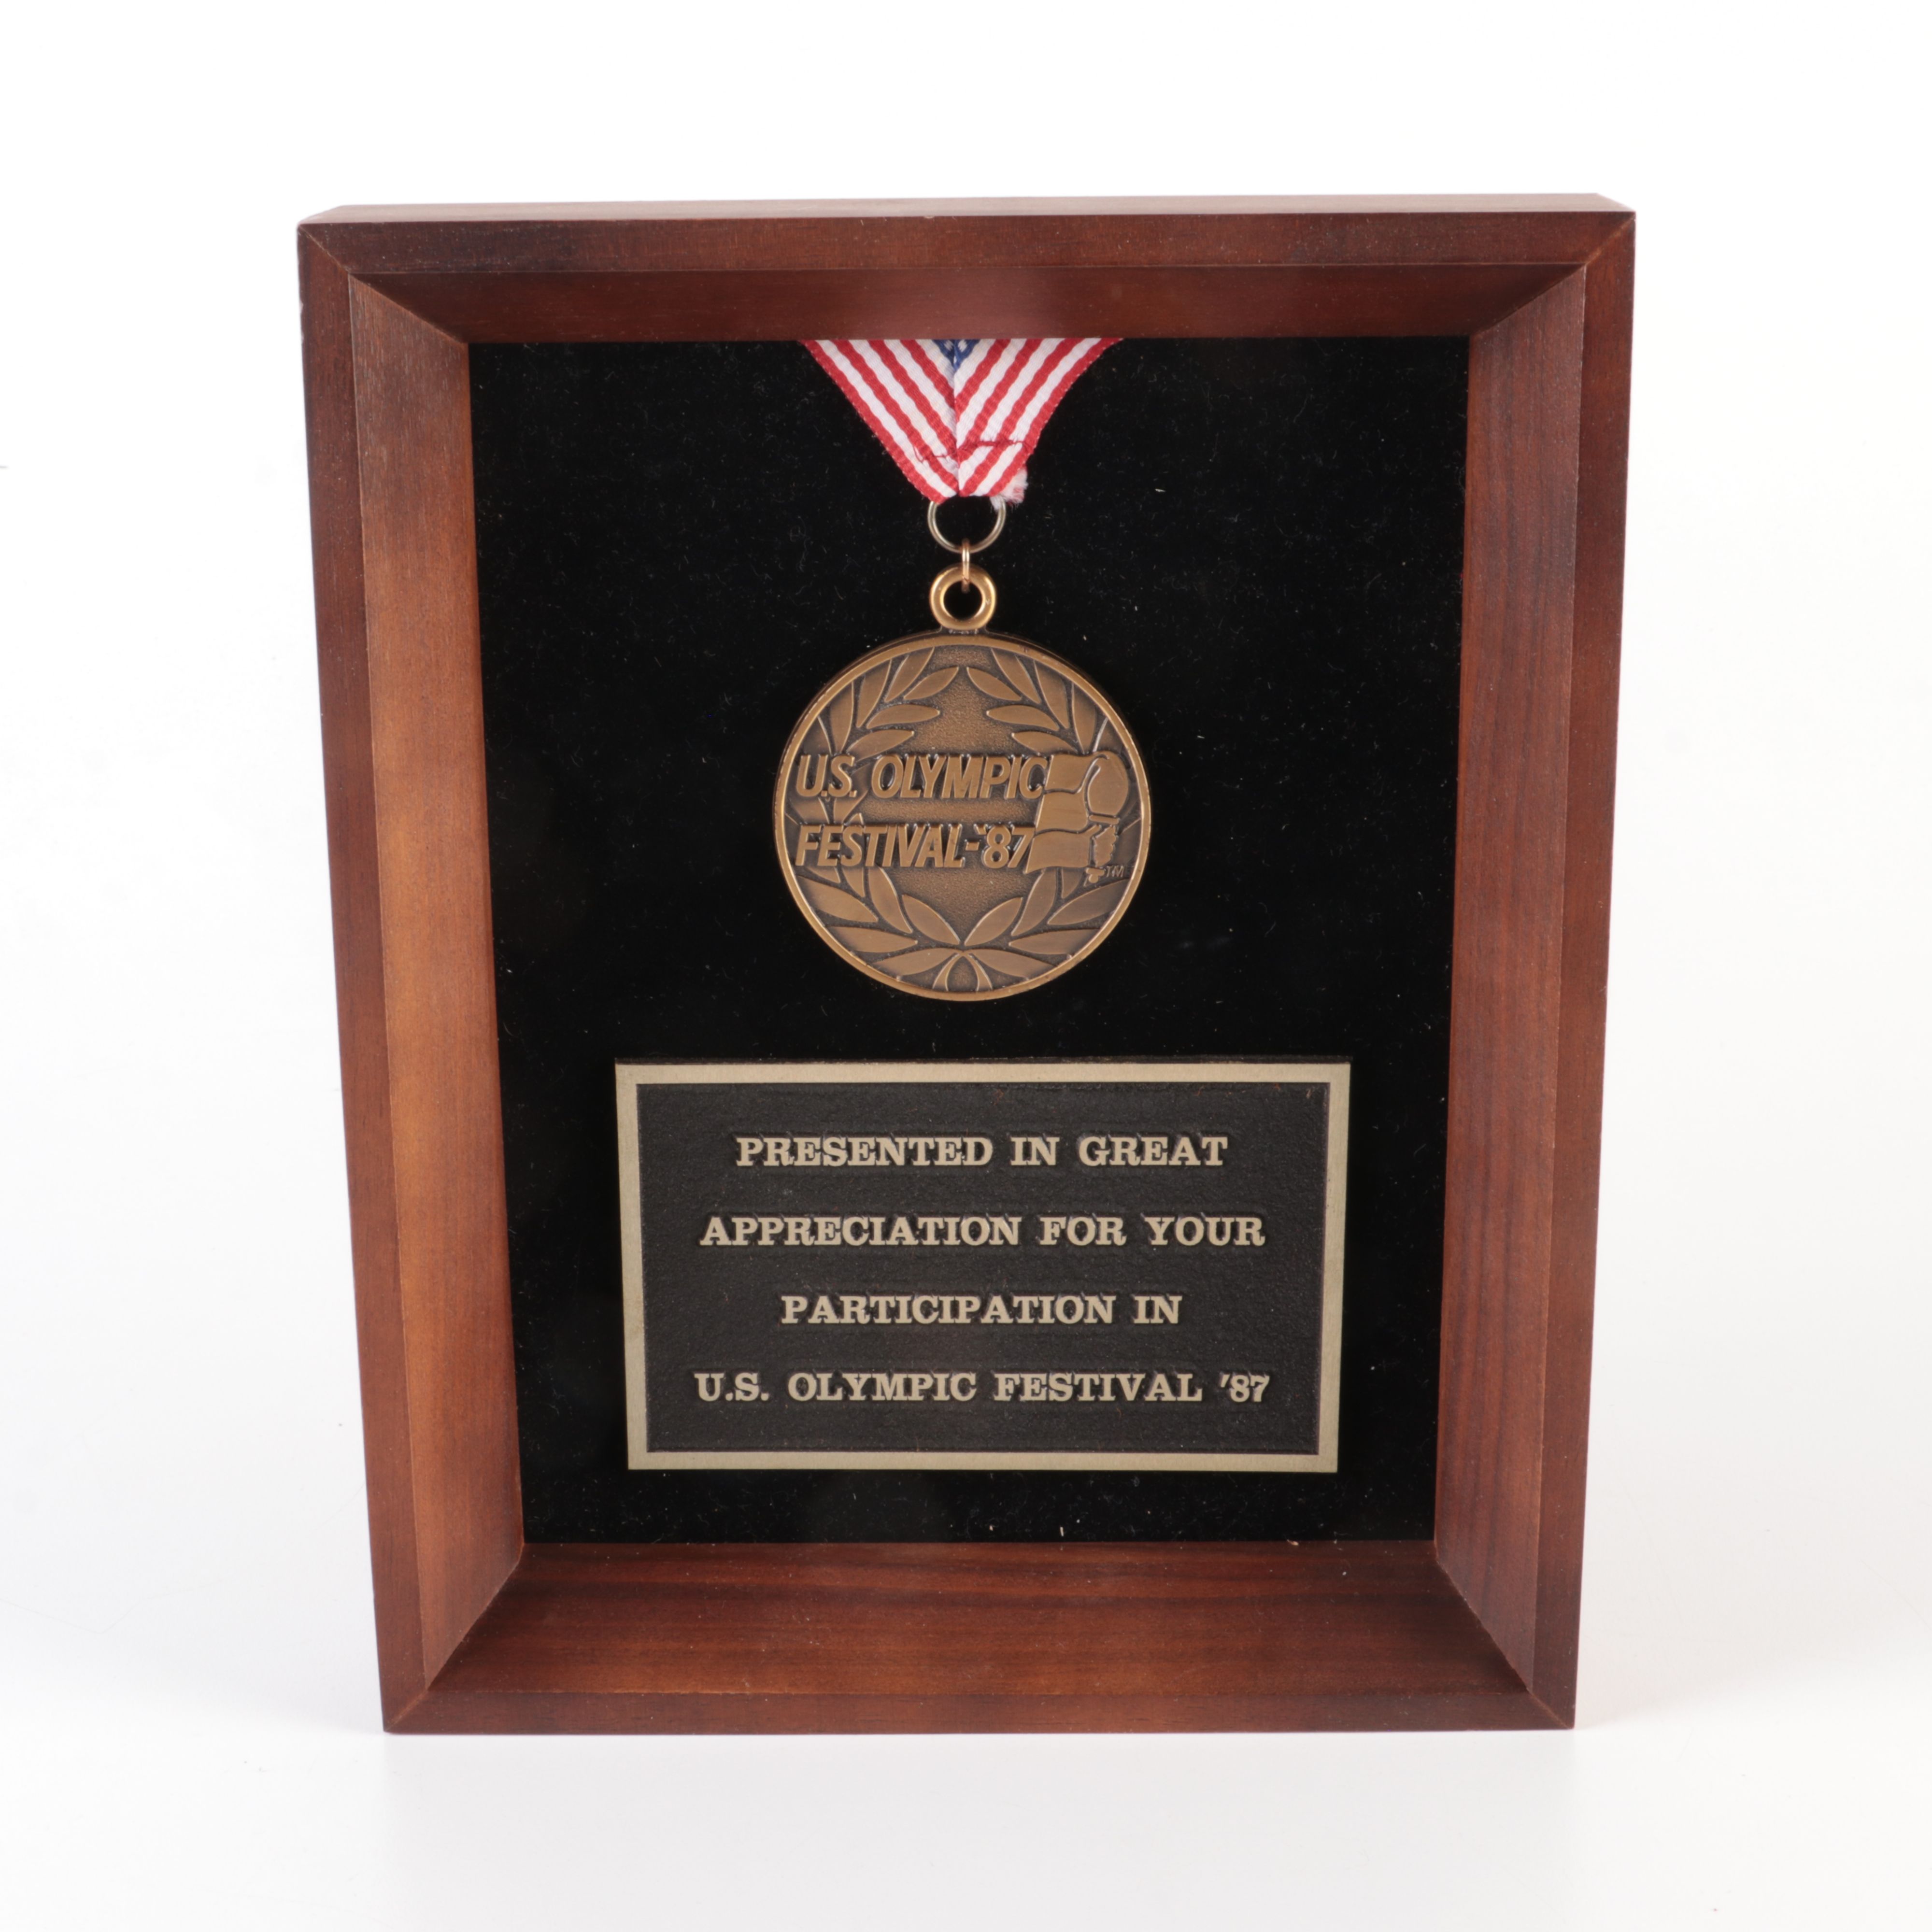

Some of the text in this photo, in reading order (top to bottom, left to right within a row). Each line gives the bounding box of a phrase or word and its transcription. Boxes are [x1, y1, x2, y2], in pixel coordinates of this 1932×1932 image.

[796, 753, 1049, 799] U.S. OLYMPIC
[1105, 865, 1124, 878] TM
[737, 1135, 1228, 1166] PRESENTED IN GREAT
[700, 1216, 1265, 1246] APPRECIATION FOR YOUR
[781, 1295, 1182, 1324] PARTICIPATION IN
[695, 1372, 1269, 1402] U.S. OLYMPIC FESTIVAL '87
